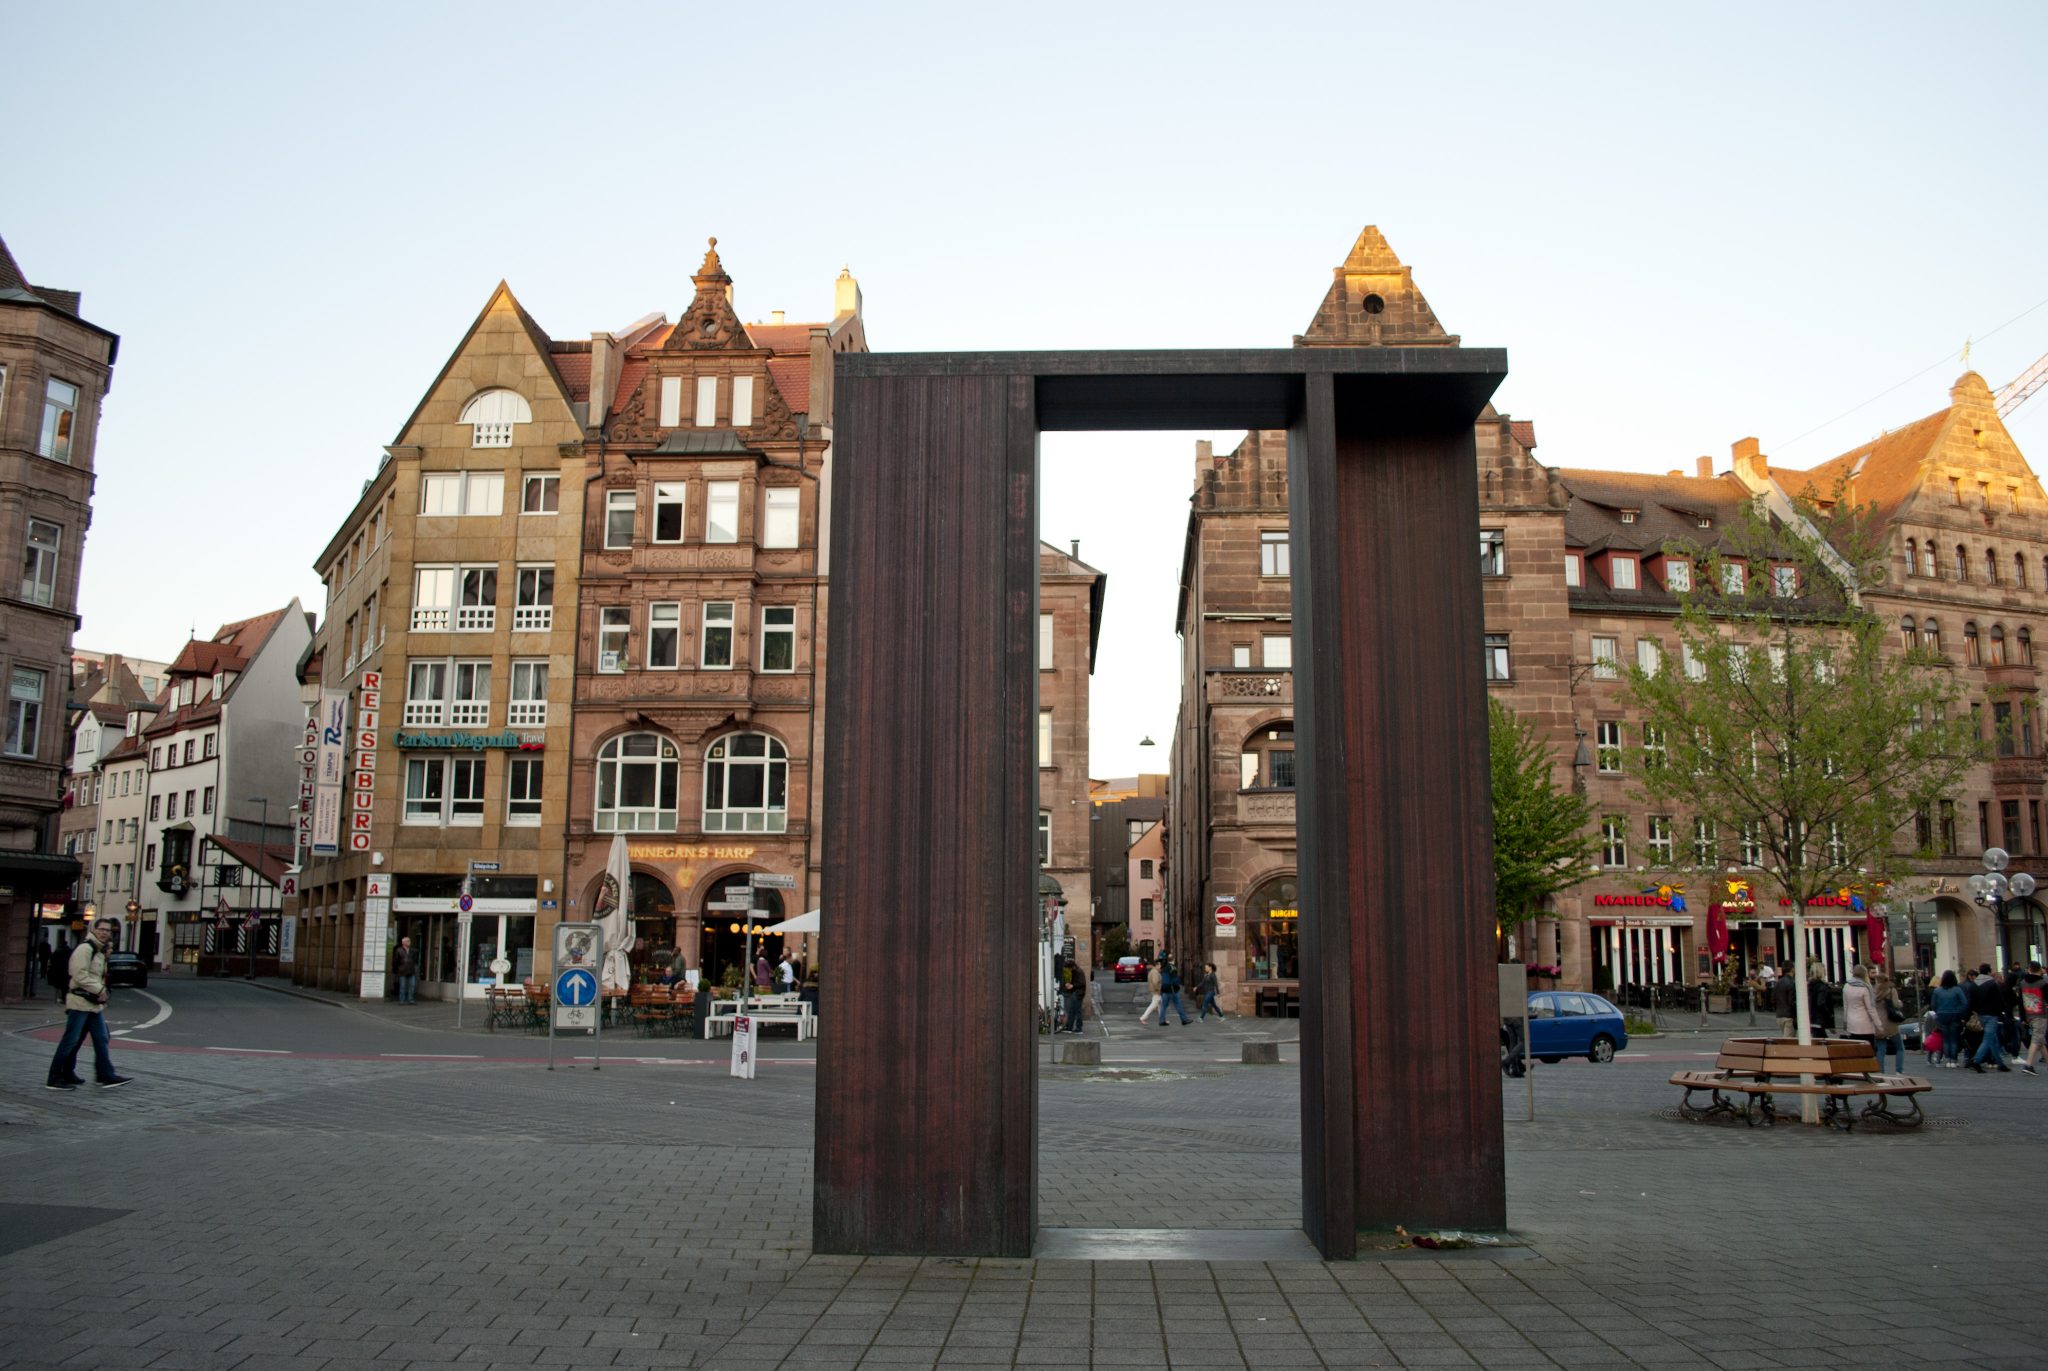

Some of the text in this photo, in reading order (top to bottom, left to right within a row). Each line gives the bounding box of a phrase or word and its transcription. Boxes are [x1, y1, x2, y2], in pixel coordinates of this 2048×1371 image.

[393, 729, 450, 747] Carlson
[521, 732, 545, 743] Travel
[300, 718, 317, 845] APOTHEKE
[714, 847, 754, 858] HARP
[1595, 895, 1672, 907] MAREDO
[1779, 895, 1851, 907] MREDO
